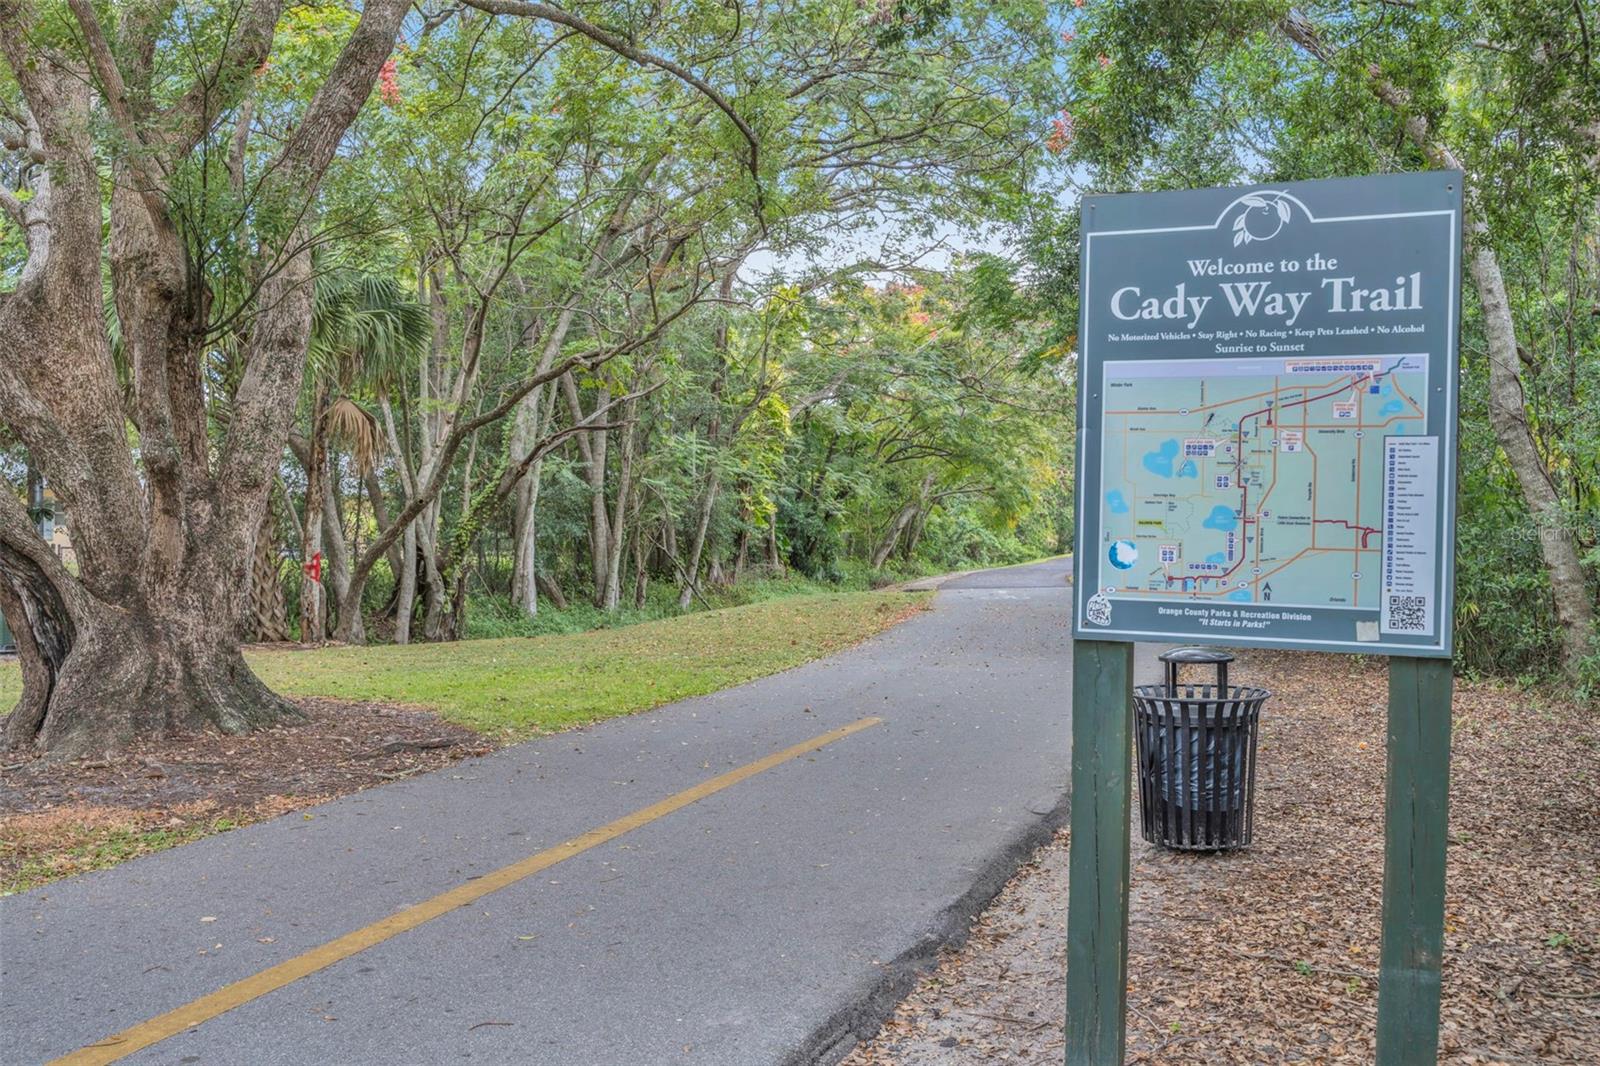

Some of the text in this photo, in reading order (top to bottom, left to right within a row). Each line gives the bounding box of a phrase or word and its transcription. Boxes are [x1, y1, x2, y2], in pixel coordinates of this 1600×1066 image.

[1187, 253, 1338, 276] Welcome to the
[1110, 272, 1423, 329] Cady Way Trail
[1108, 324, 1425, 342] No Motorized Vehicles Stay Right No Racing Keep Pets Leashed No Alcohol
[1215, 342, 1305, 354] Sunrise to Sunset
[1263, 592, 1271, 600] N
[1158, 606, 1312, 621] Orange County Parks & Recreation Division
[1209, 618, 1232, 627] Starts
[1233, 619, 1241, 628] in
